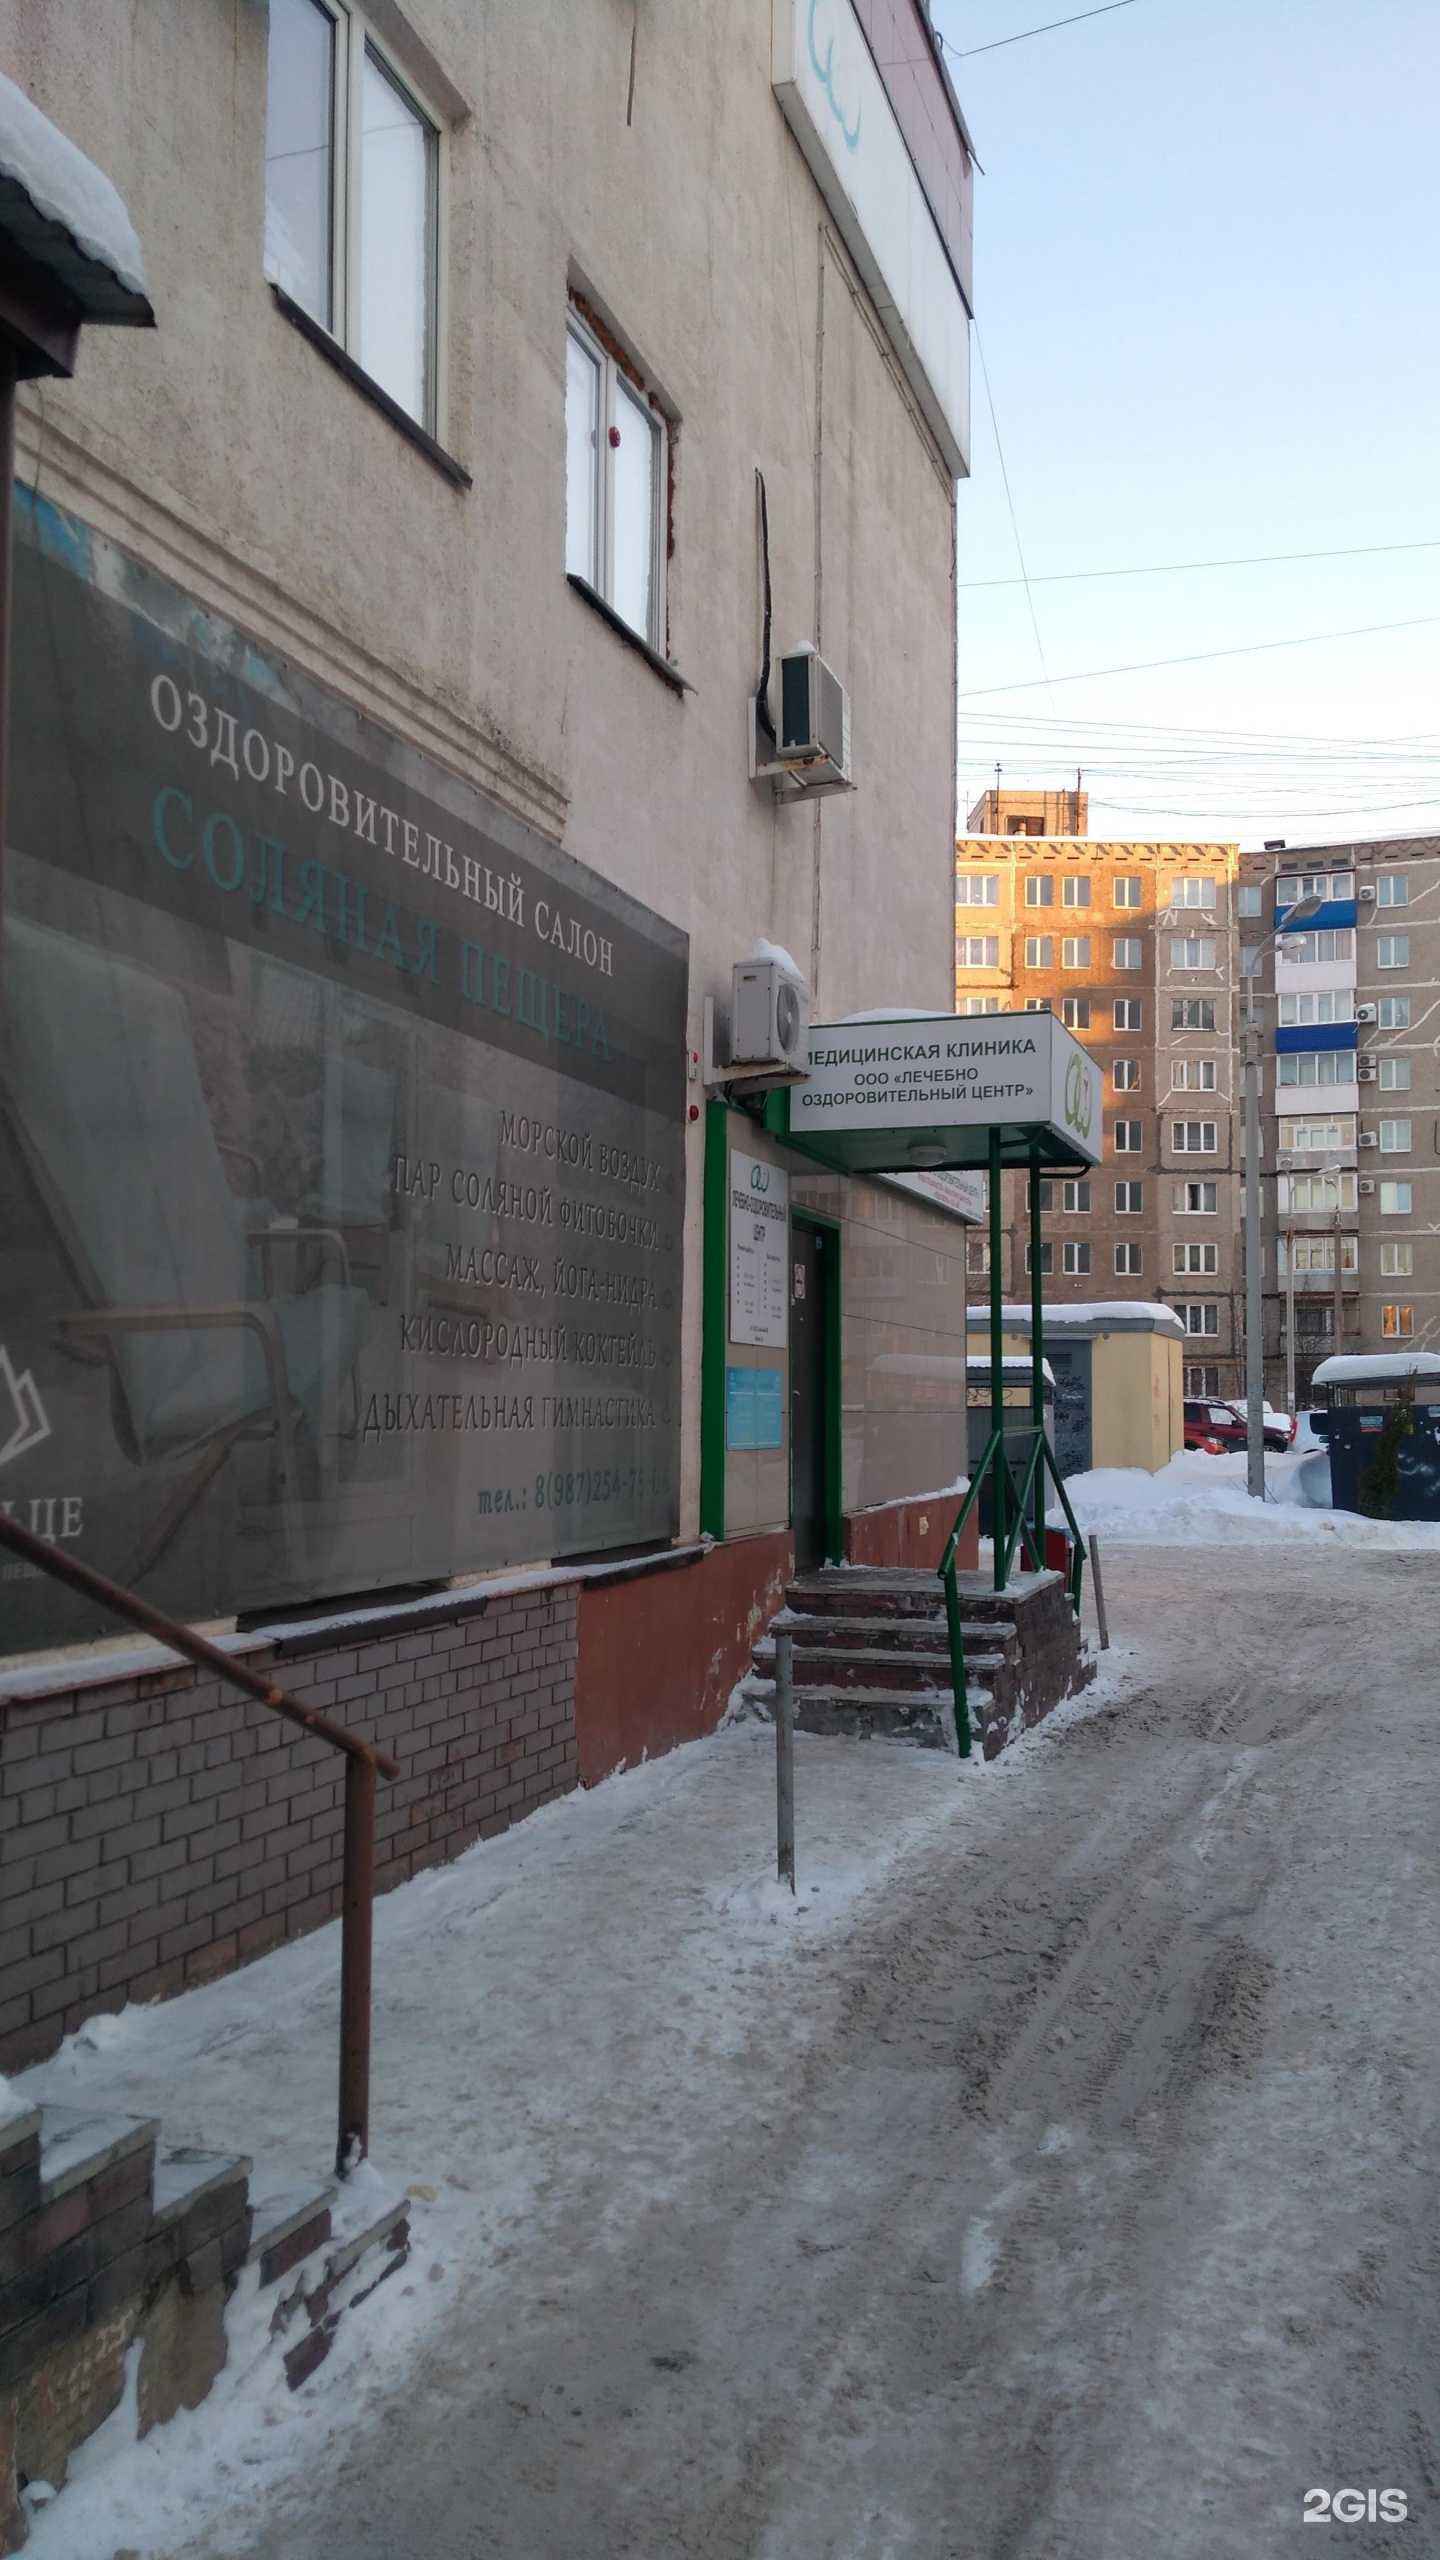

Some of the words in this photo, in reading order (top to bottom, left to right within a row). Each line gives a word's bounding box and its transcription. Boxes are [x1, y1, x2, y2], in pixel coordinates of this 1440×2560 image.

[150, 673, 526, 929] ОЗДОРОВИТЕЛЬНЫЙ
[533, 899, 615, 978] САЛОН
[151, 785, 441, 987] СОЛЯНАЯ
[460, 938, 614, 1063] ПЕЩЕРА
[854, 1072, 889, 1086] ООО
[894, 1067, 979, 1084] «ЛЕЧЕБНО
[946, 1038, 1037, 1059] КЛИНИКА
[802, 1084, 967, 1108] ОЗДОРОВИТЕЛЬНЫЙ
[971, 1082, 1034, 1101] ЦЕНТР»
[499, 1109, 593, 1173] МОРСКОЙ
[599, 1143, 662, 1193] ВОЗДУХ
[391, 1153, 441, 1201] ПАР
[450, 1168, 553, 1226] СОЛЯНОЙ
[445, 1243, 547, 1299] МАССАЖ,
[399, 1313, 569, 1370] КИСЛОРОДНЫЙ
[574, 1330, 658, 1370] КОКТЕЙЛЬ
[361, 1394, 536, 1444] ДЫХАТЕЛЬНАЯ
[541, 1396, 657, 1431] ГИМНАСТИКА
[477, 1487, 528, 1515] тел.:
